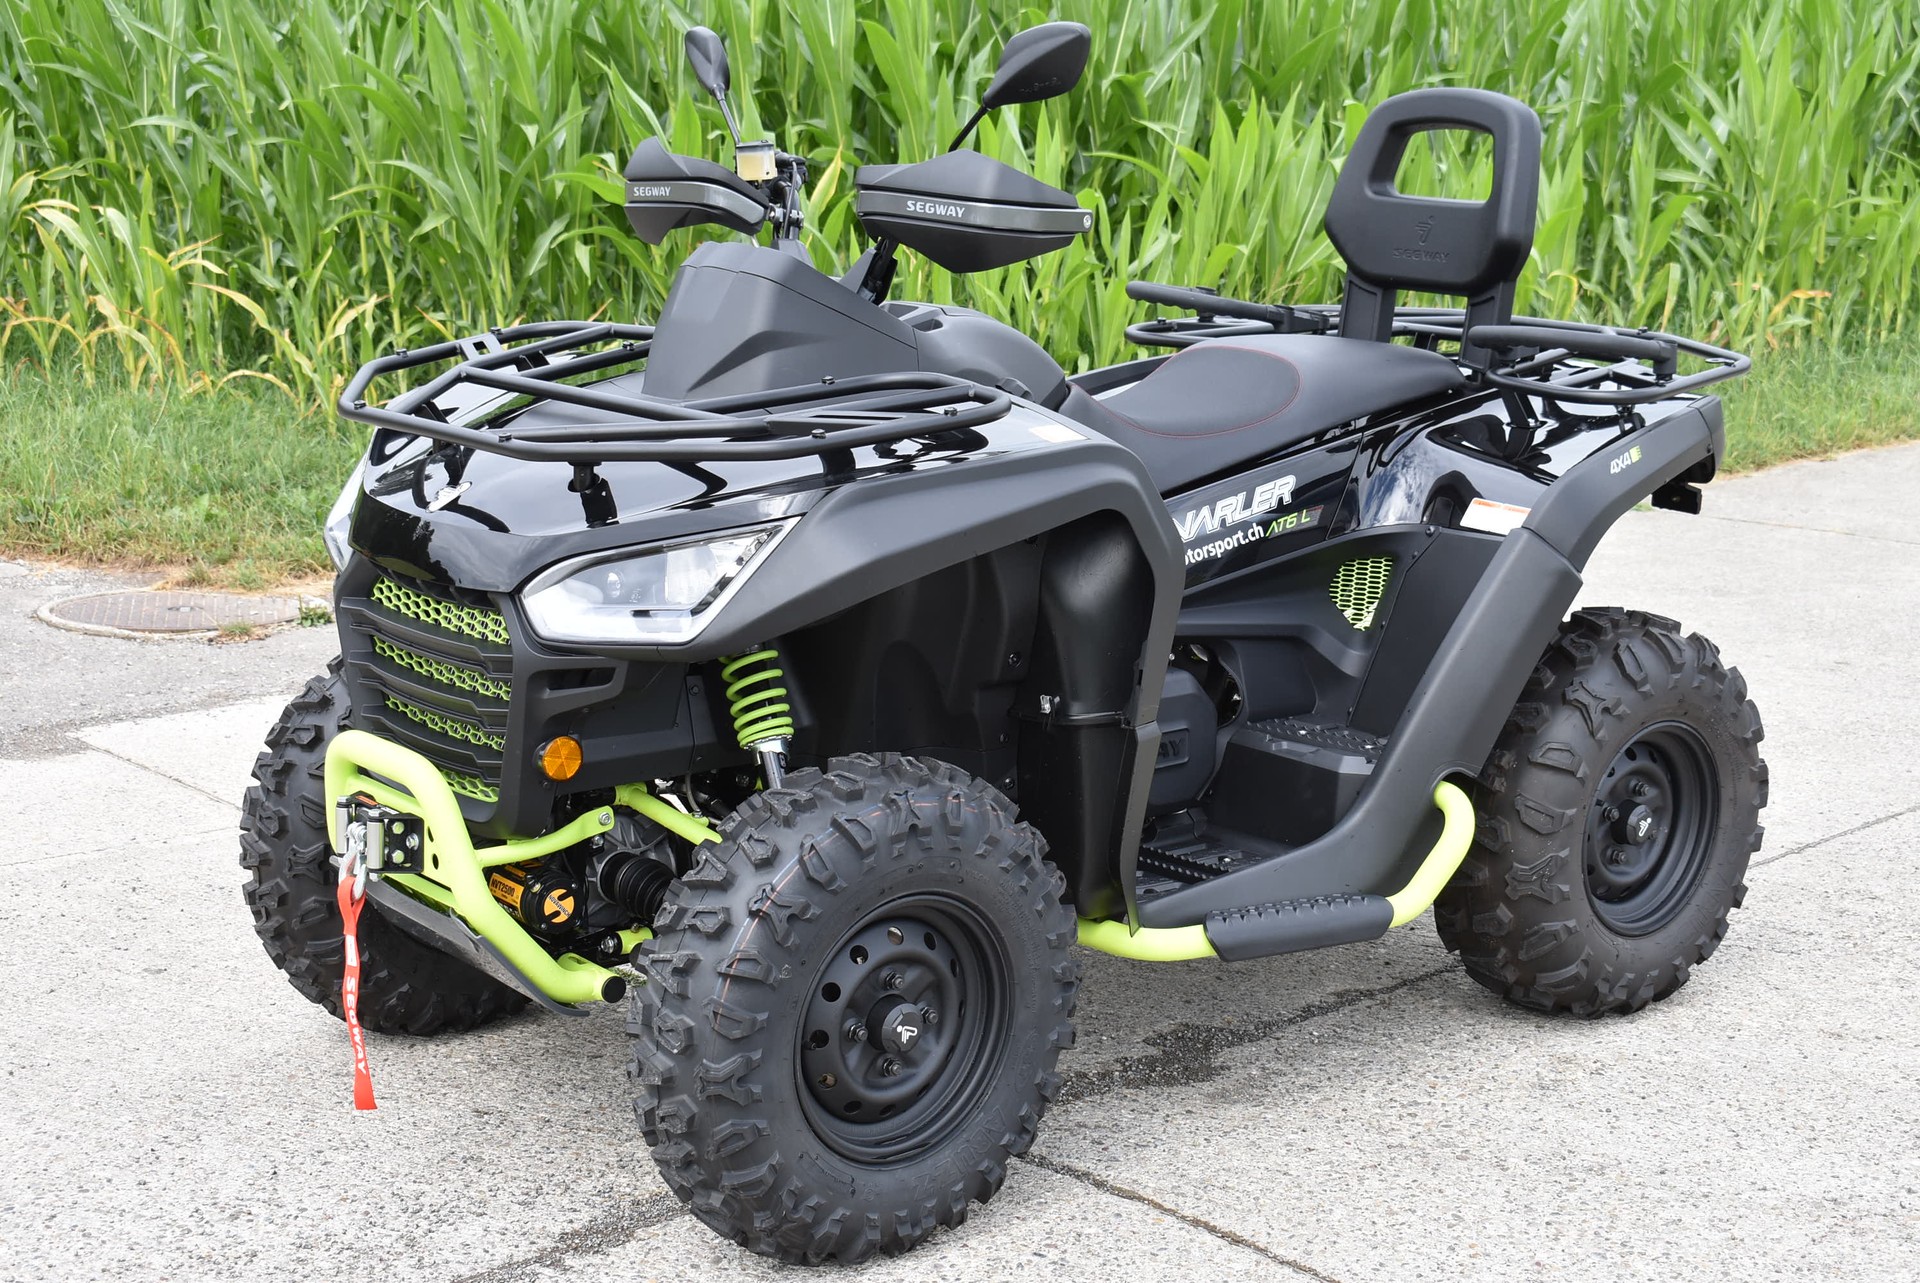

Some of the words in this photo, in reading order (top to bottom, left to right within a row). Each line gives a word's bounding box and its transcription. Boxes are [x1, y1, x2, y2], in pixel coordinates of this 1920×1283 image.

[633, 186, 671, 197] SEGWAY
[906, 200, 965, 218] SEGWAY
[1392, 247, 1451, 263] SEGWAY
[1610, 451, 1631, 474] 4X4
[1265, 511, 1298, 537] AT6
